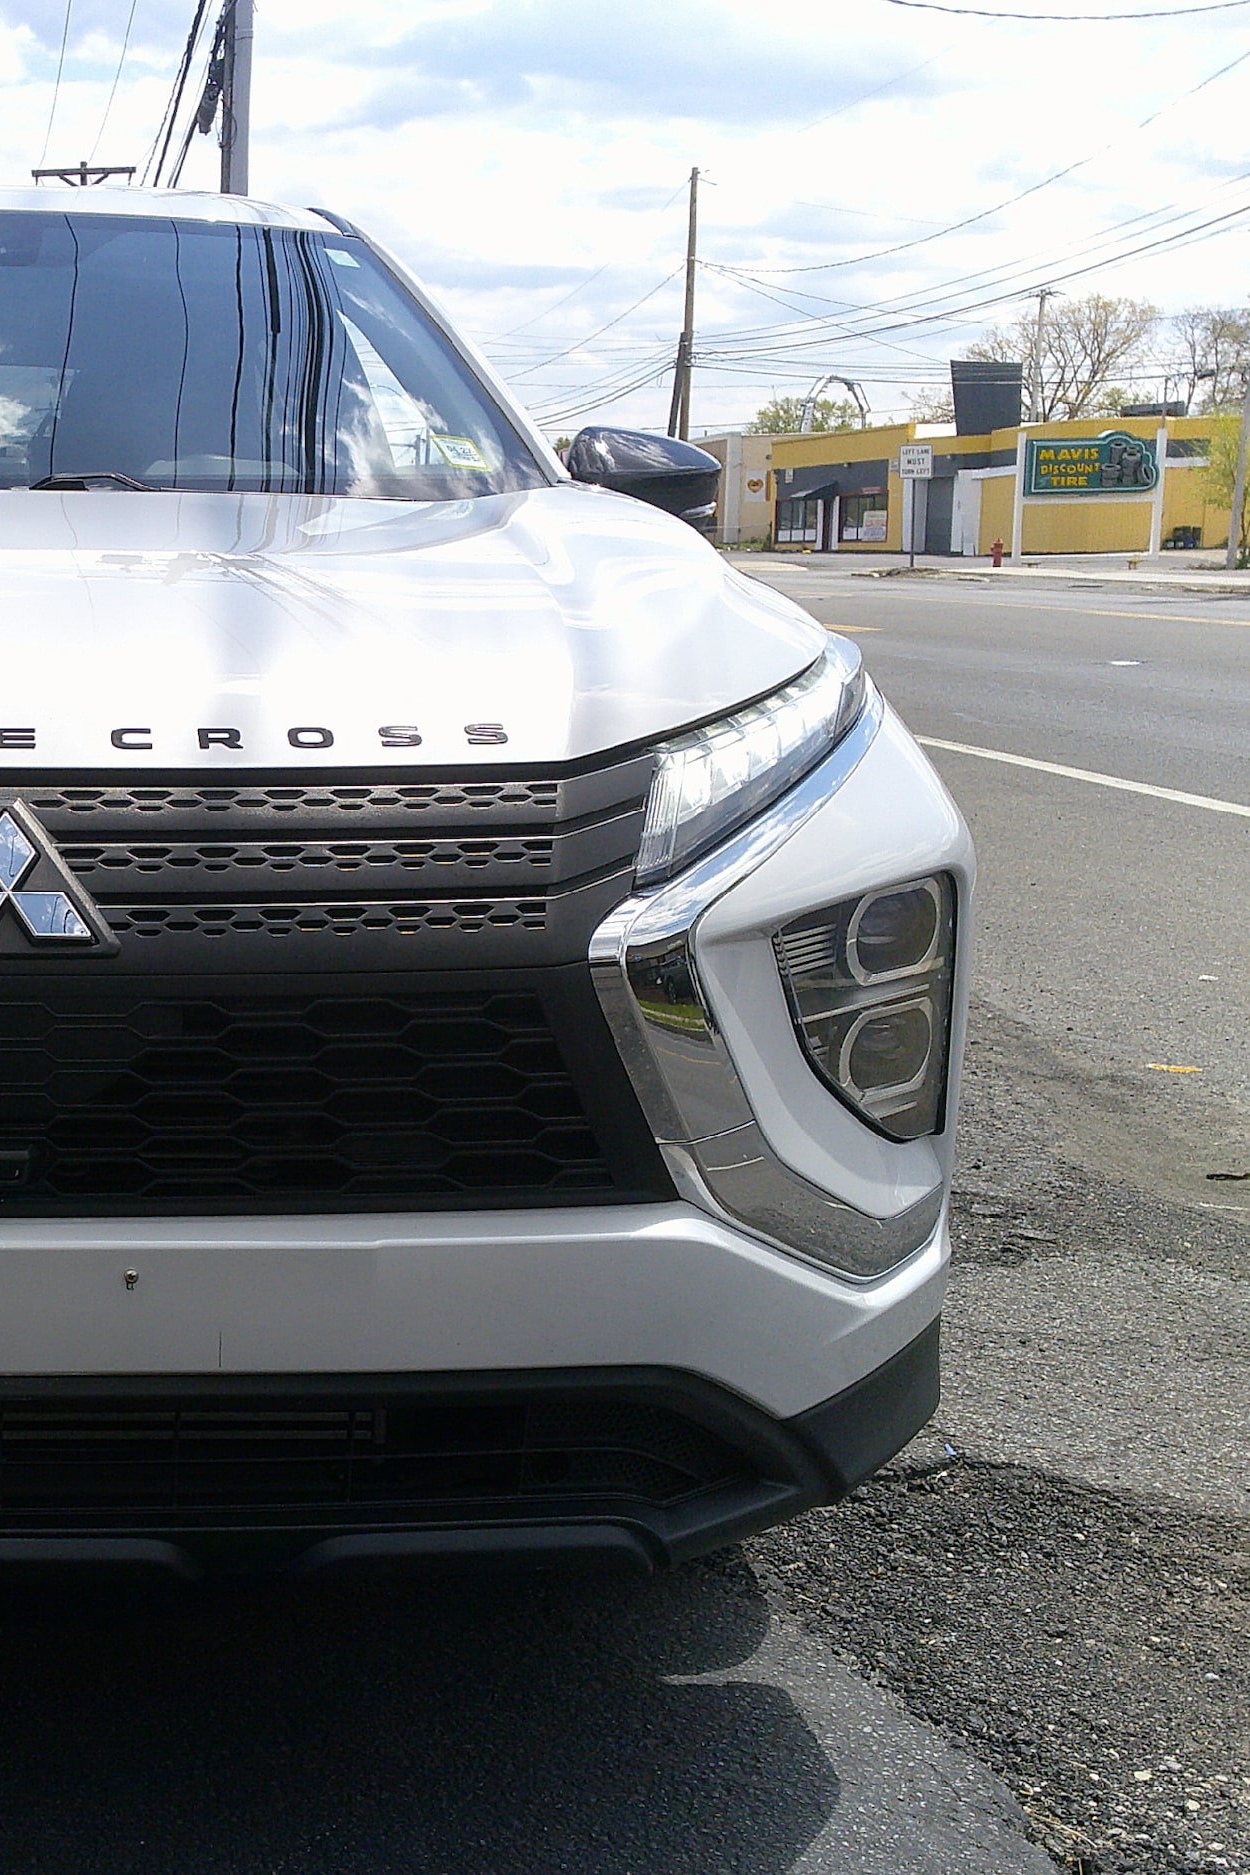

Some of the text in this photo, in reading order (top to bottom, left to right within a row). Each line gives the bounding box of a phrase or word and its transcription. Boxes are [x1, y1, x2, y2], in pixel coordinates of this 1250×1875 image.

[1039, 447, 1099, 460] MAVIS
[907, 458, 925, 466] MUST
[1040, 462, 1101, 475] DISCOUNT
[1051, 476, 1088, 486] TIRE
[110, 722, 509, 750] CROSS
